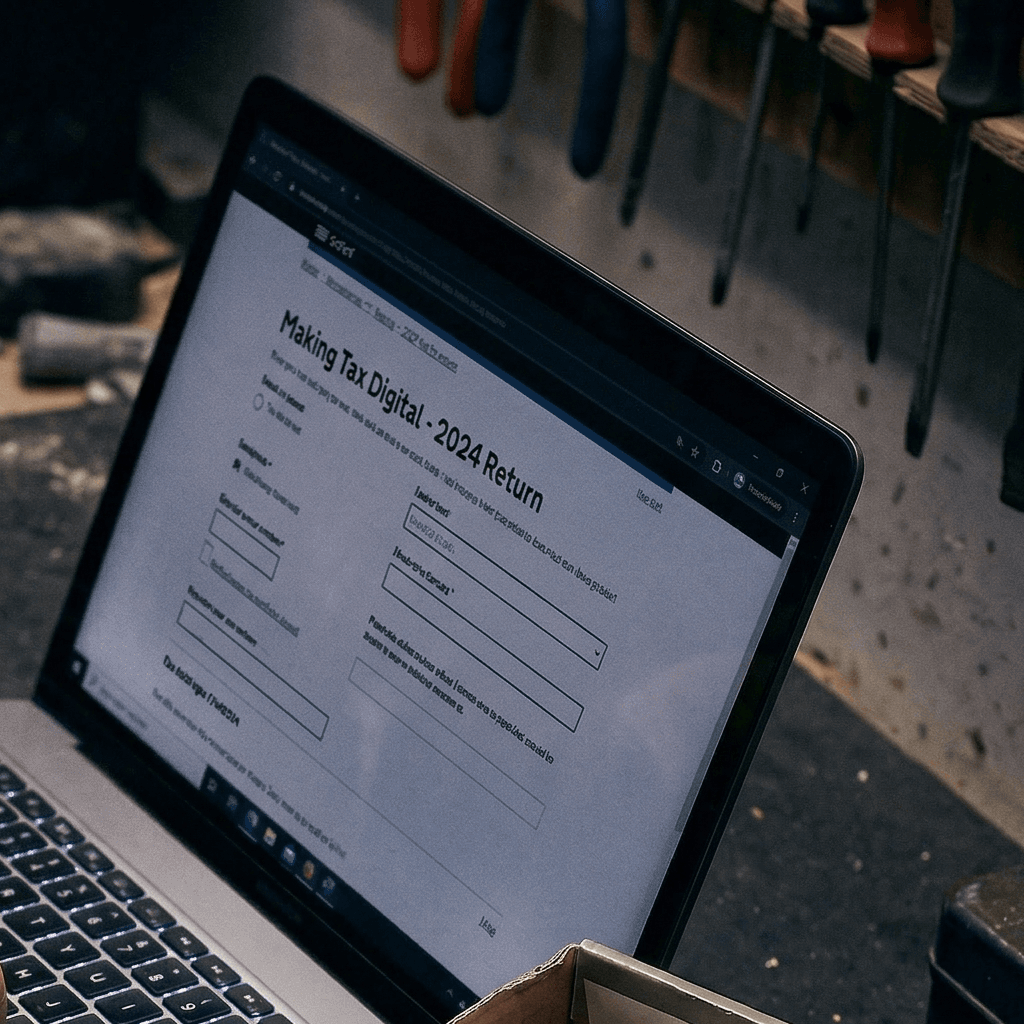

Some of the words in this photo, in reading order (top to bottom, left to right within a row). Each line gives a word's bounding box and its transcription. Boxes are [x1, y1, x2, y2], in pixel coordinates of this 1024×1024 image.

[279, 309, 338, 373] Making
[339, 348, 368, 390] Tax
[366, 370, 425, 430] Digital
[433, 417, 484, 470] 2024
[481, 449, 545, 514] Return
